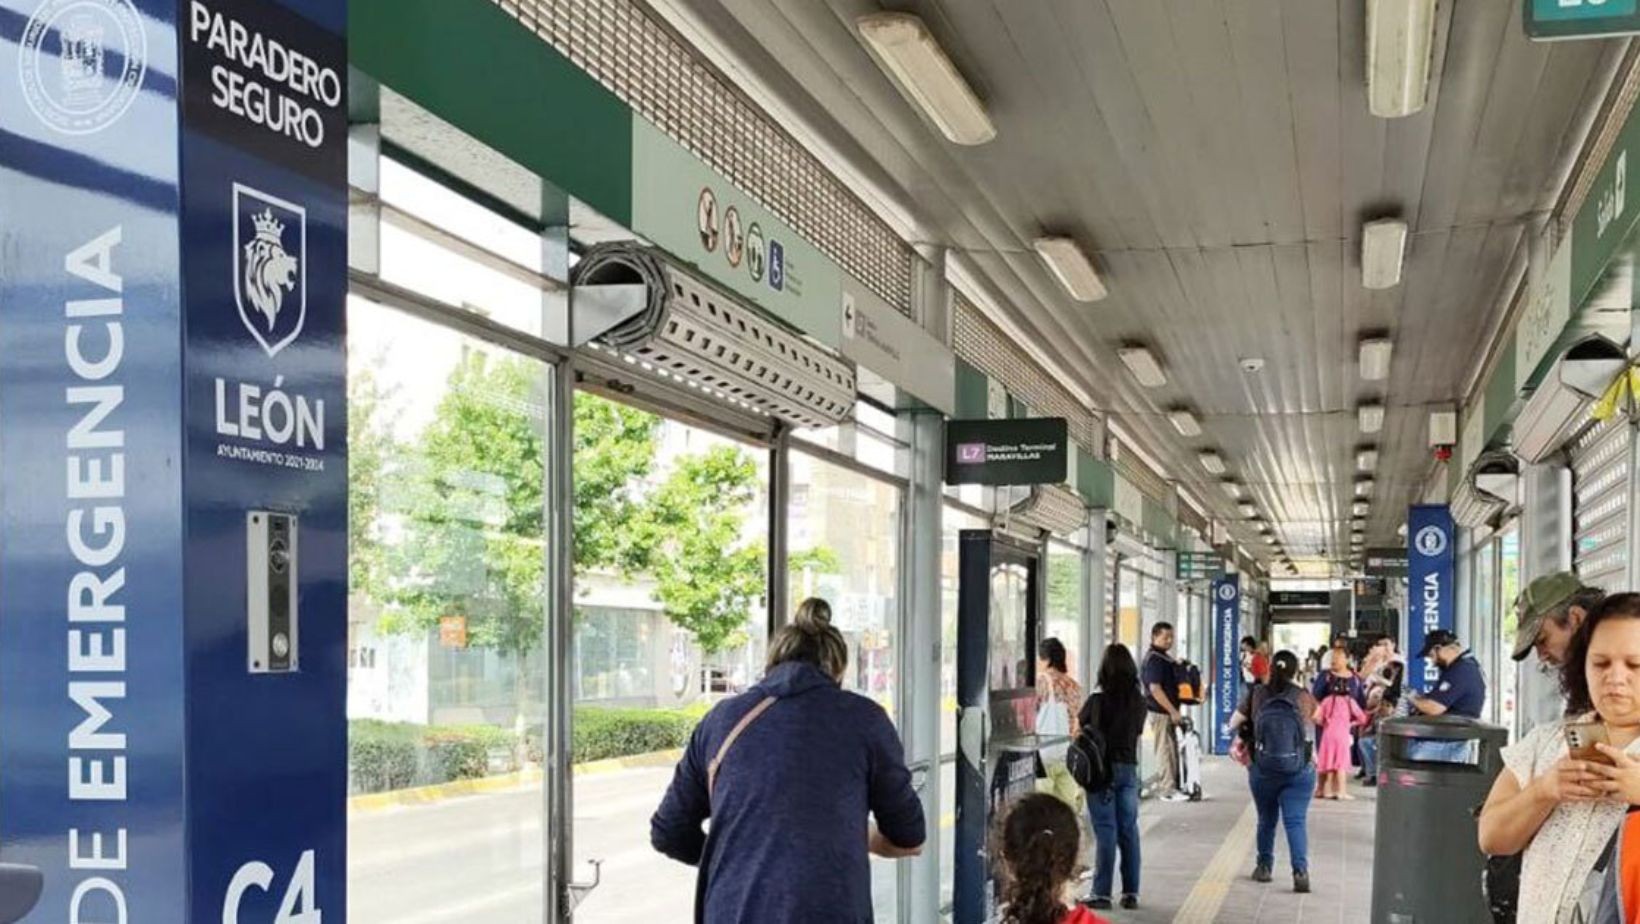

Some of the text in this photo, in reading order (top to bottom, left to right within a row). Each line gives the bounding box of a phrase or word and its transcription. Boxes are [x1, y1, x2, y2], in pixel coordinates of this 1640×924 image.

[190, 1, 341, 107] PARADERO
[211, 65, 324, 147] SEGURO
[215, 376, 324, 450] LEÓN
[217, 445, 284, 464] AYUNTAMIENTO
[962, 448, 980, 460] L7
[1021, 443, 1056, 451] Terminal
[65, 224, 128, 924] DE EMERGENCIA
[1222, 608, 1233, 666] EMERGENCIA
[1423, 572, 1440, 680] EMGENCIA
[1222, 678, 1232, 712] BOTÓN
[1223, 667, 1232, 678] DE
[222, 849, 323, 924] C4
